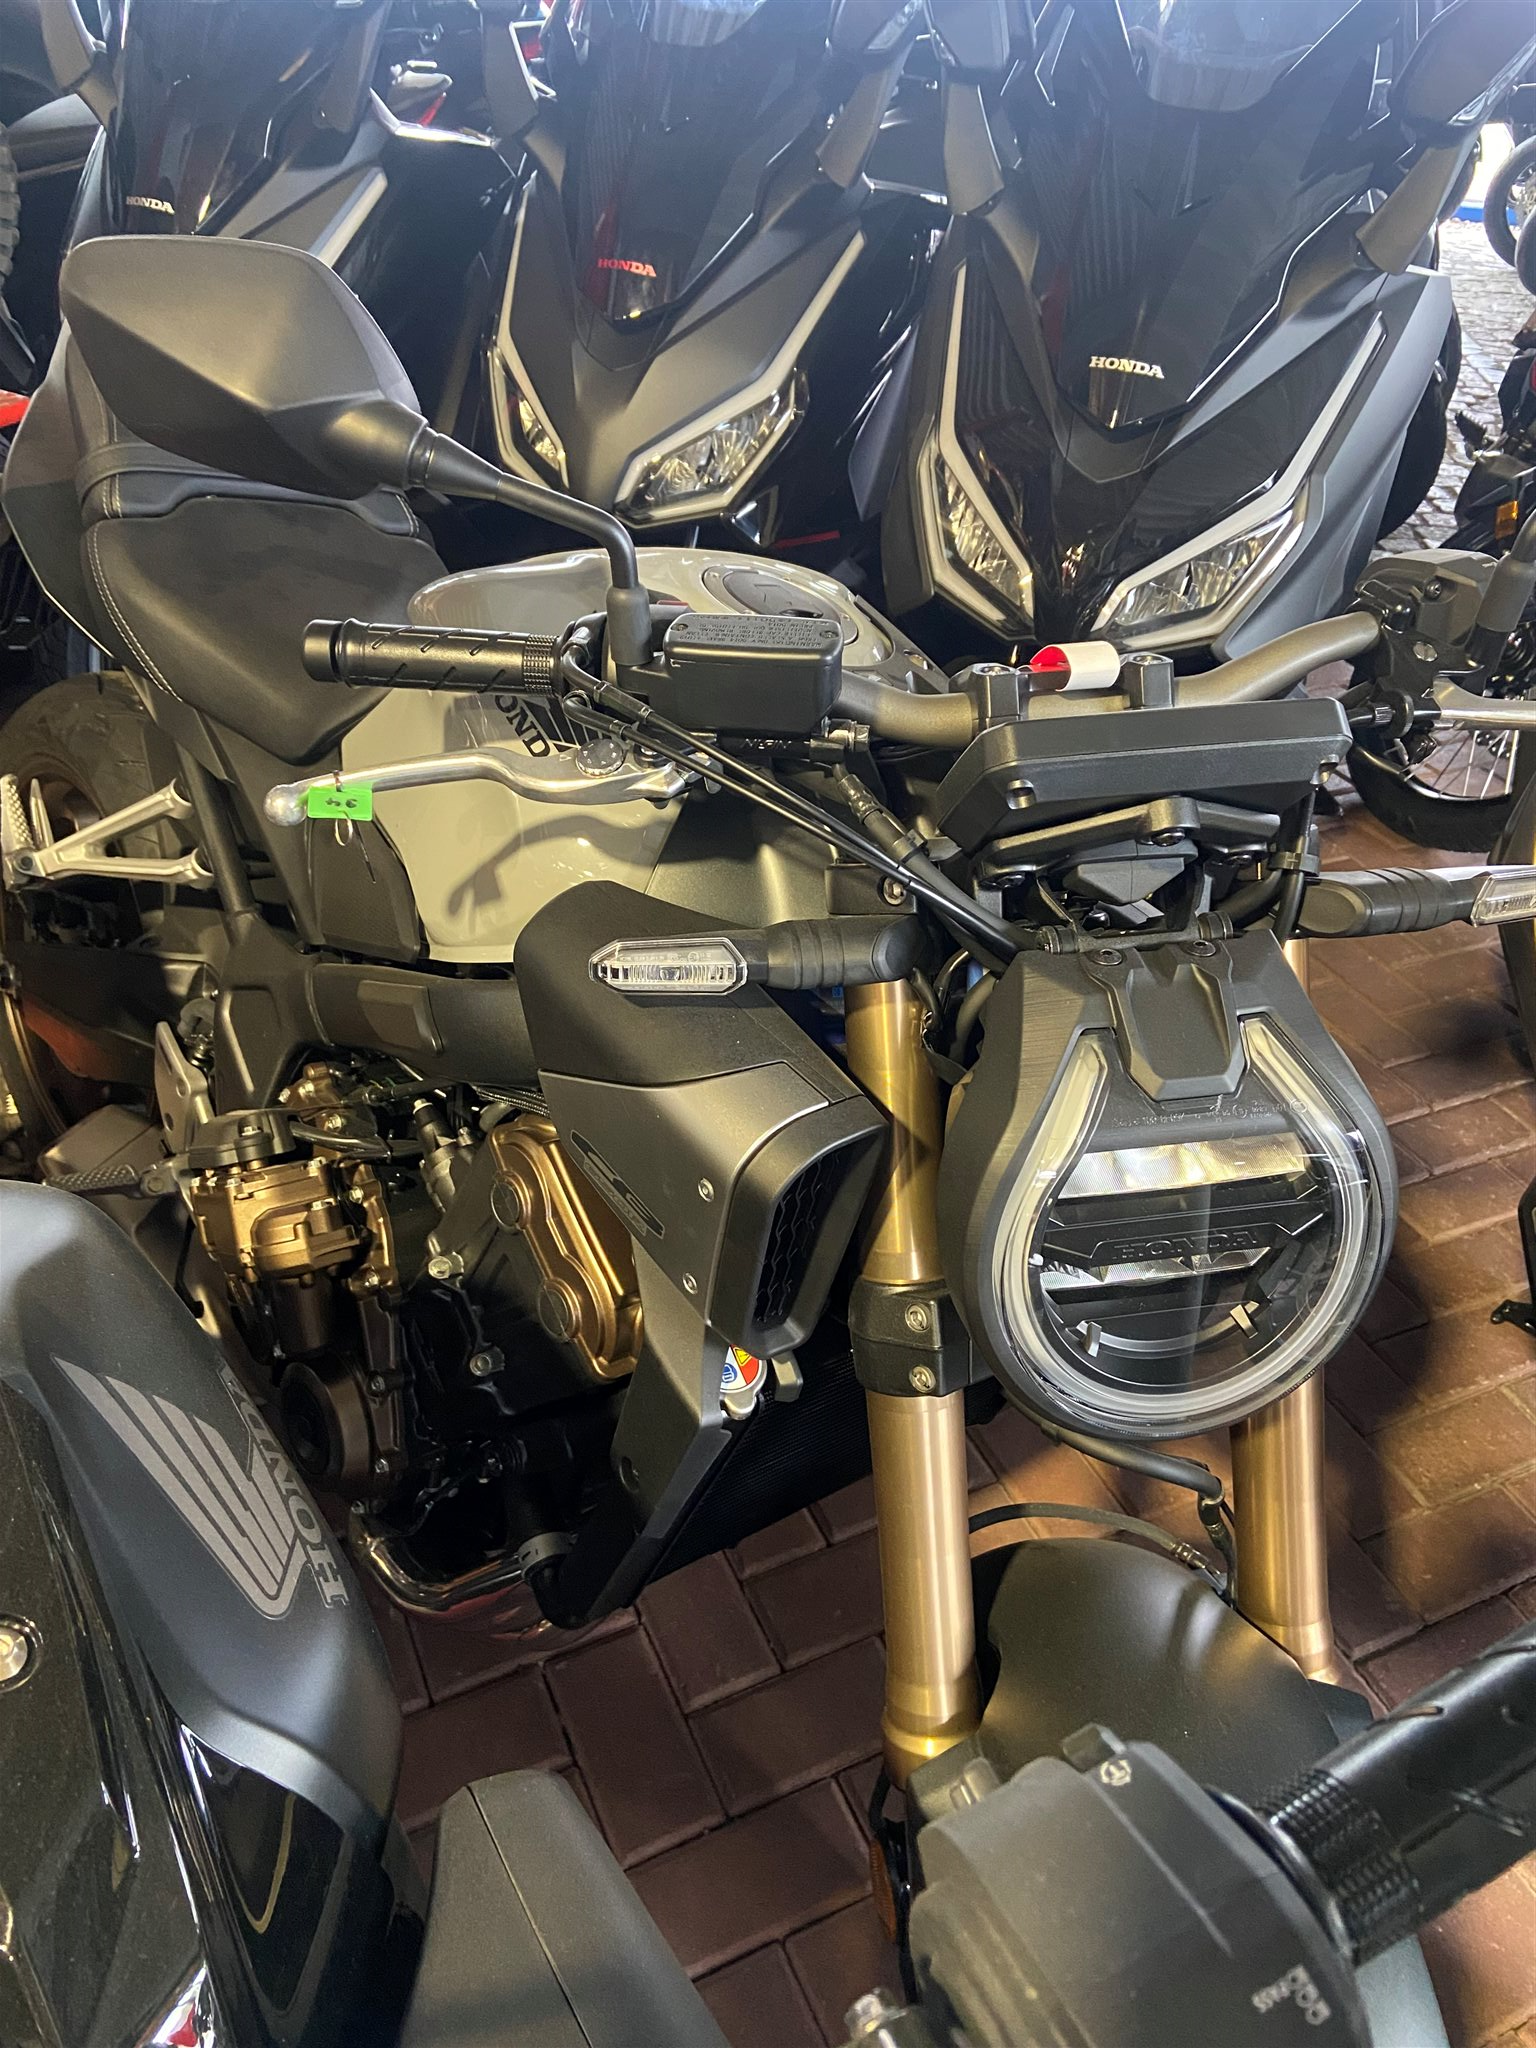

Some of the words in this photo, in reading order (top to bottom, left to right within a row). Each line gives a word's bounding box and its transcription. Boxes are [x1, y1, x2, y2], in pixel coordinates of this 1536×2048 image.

[126, 195, 176, 215] HONDA
[598, 257, 657, 278] HONDA
[1089, 356, 1165, 379] HONDA
[495, 695, 552, 758] OND
[1113, 1230, 1258, 1260] HONDA
